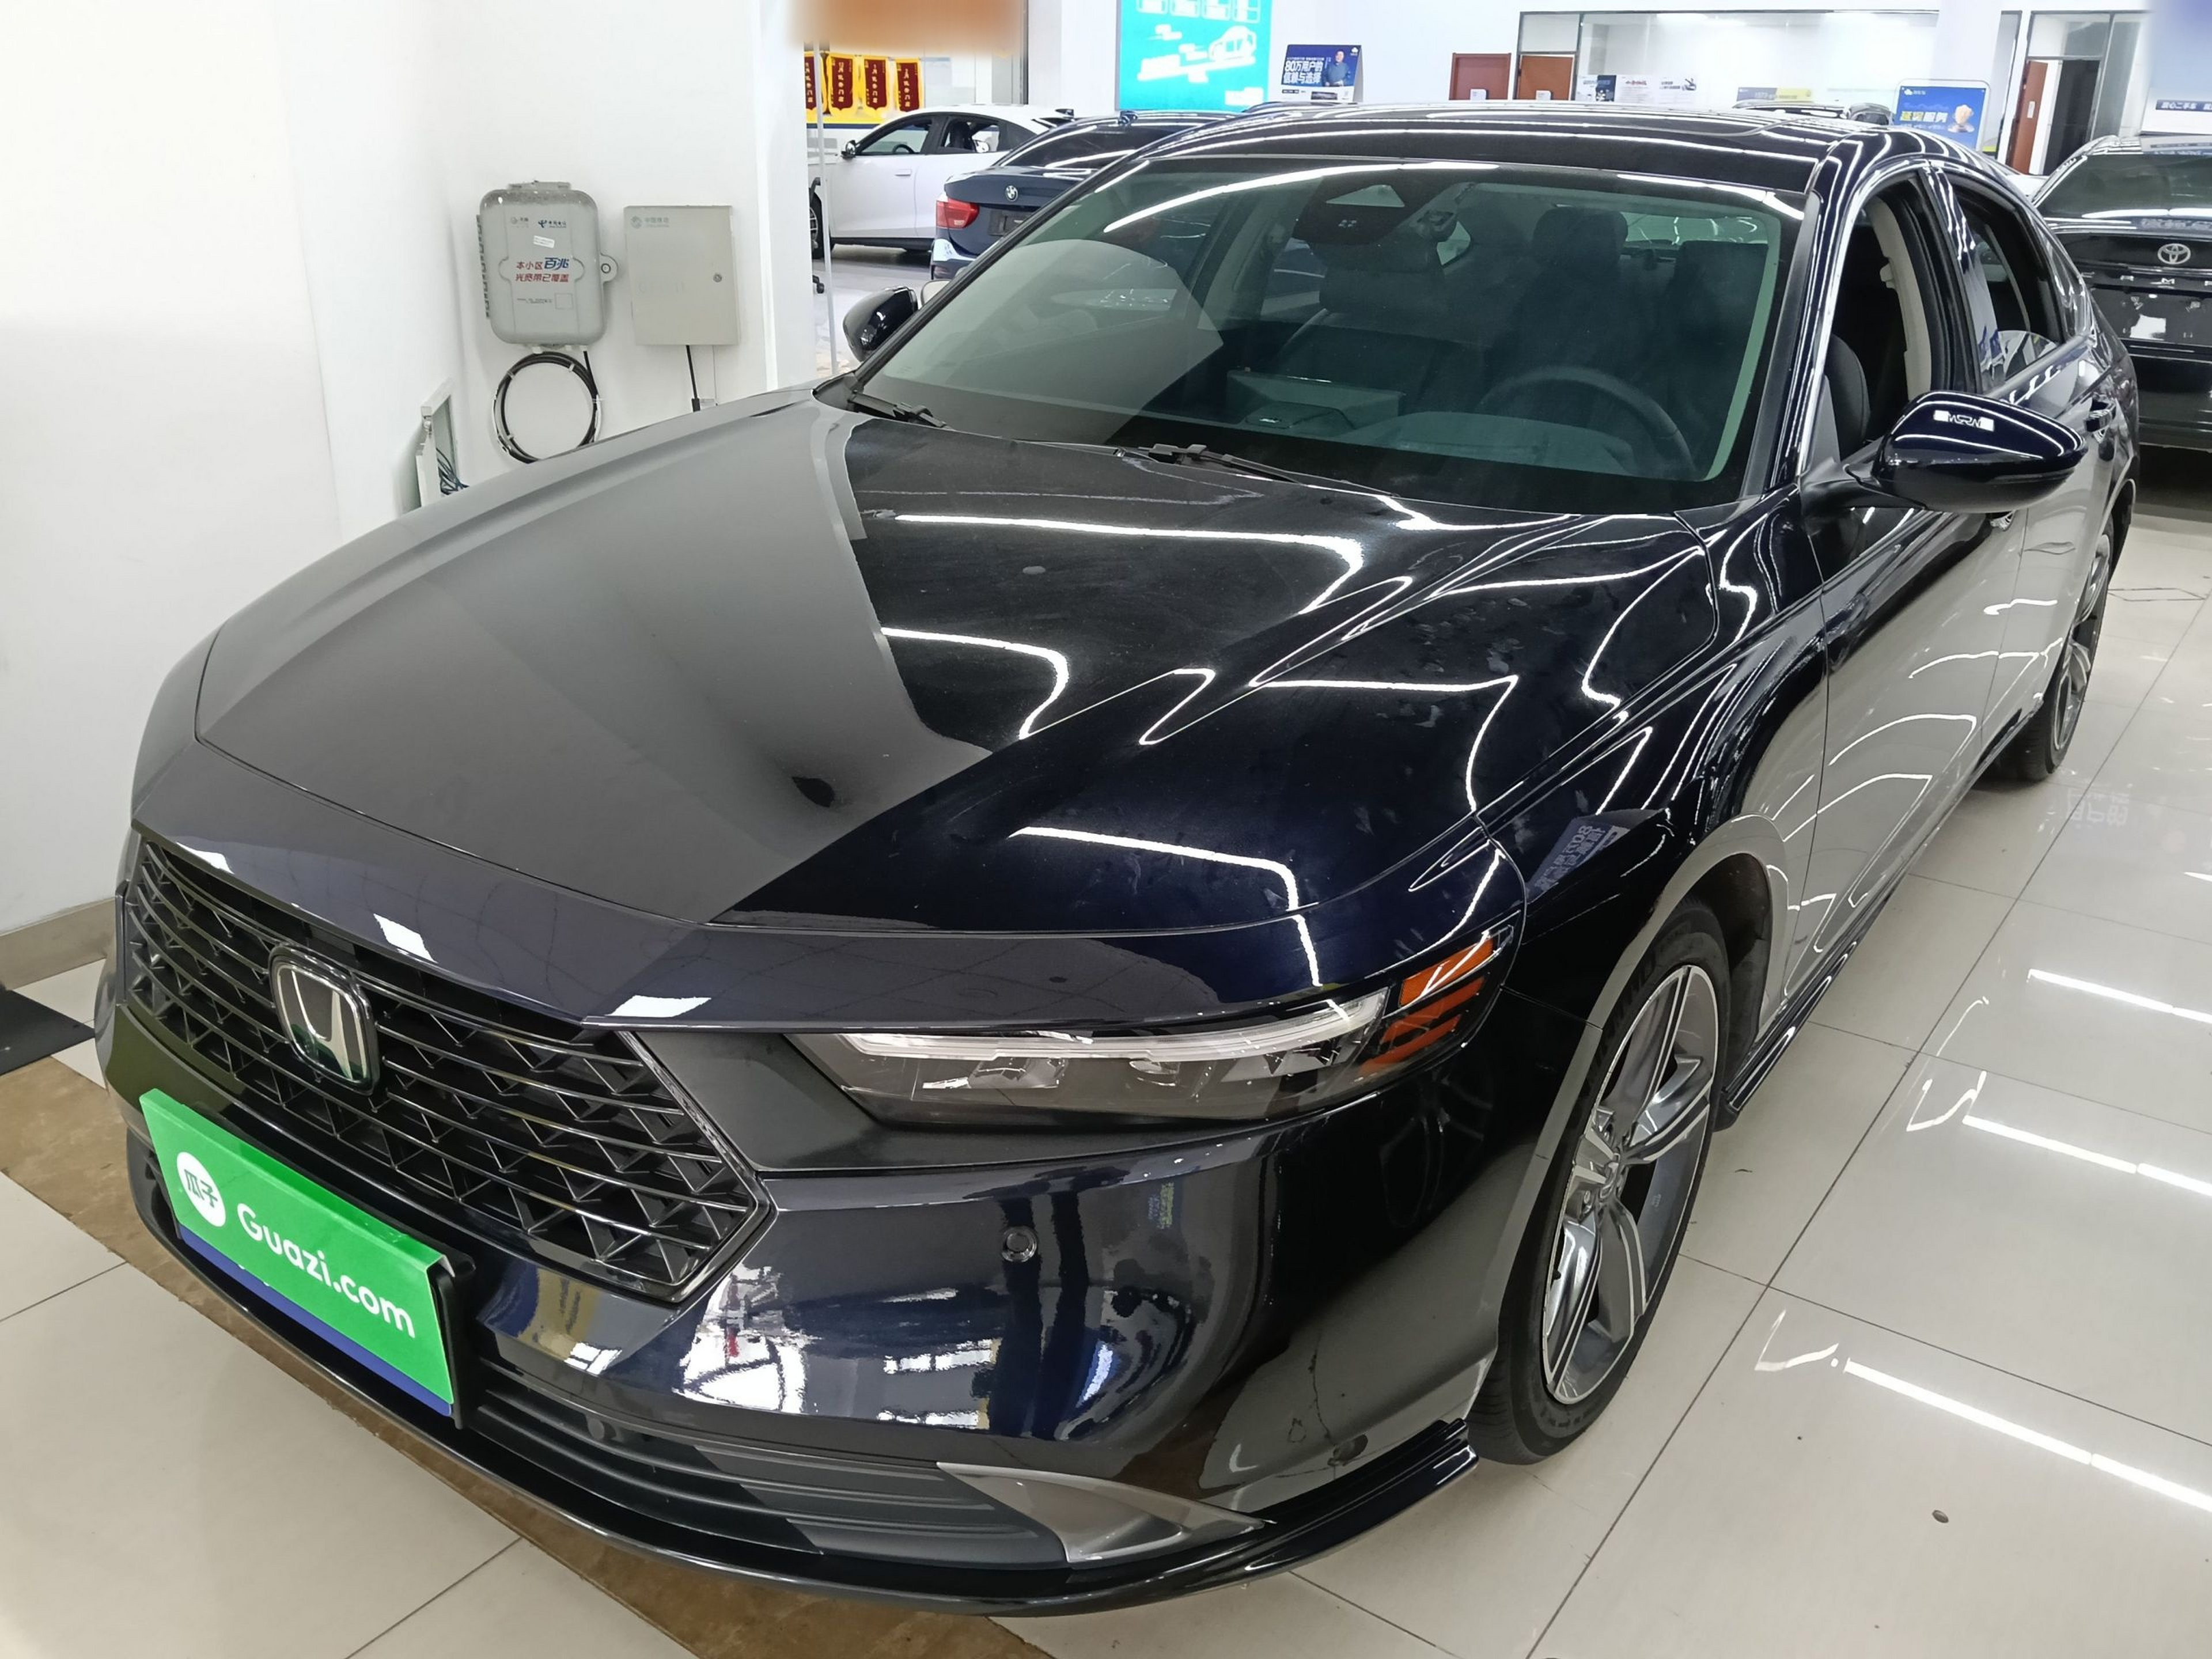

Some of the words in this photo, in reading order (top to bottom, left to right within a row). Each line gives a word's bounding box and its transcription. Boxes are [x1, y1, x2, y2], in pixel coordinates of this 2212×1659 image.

[1285, 60, 1324, 71] 80万用户的
[184, 1169, 218, 1208] 瓜子
[237, 1203, 415, 1338] Guazi.com
